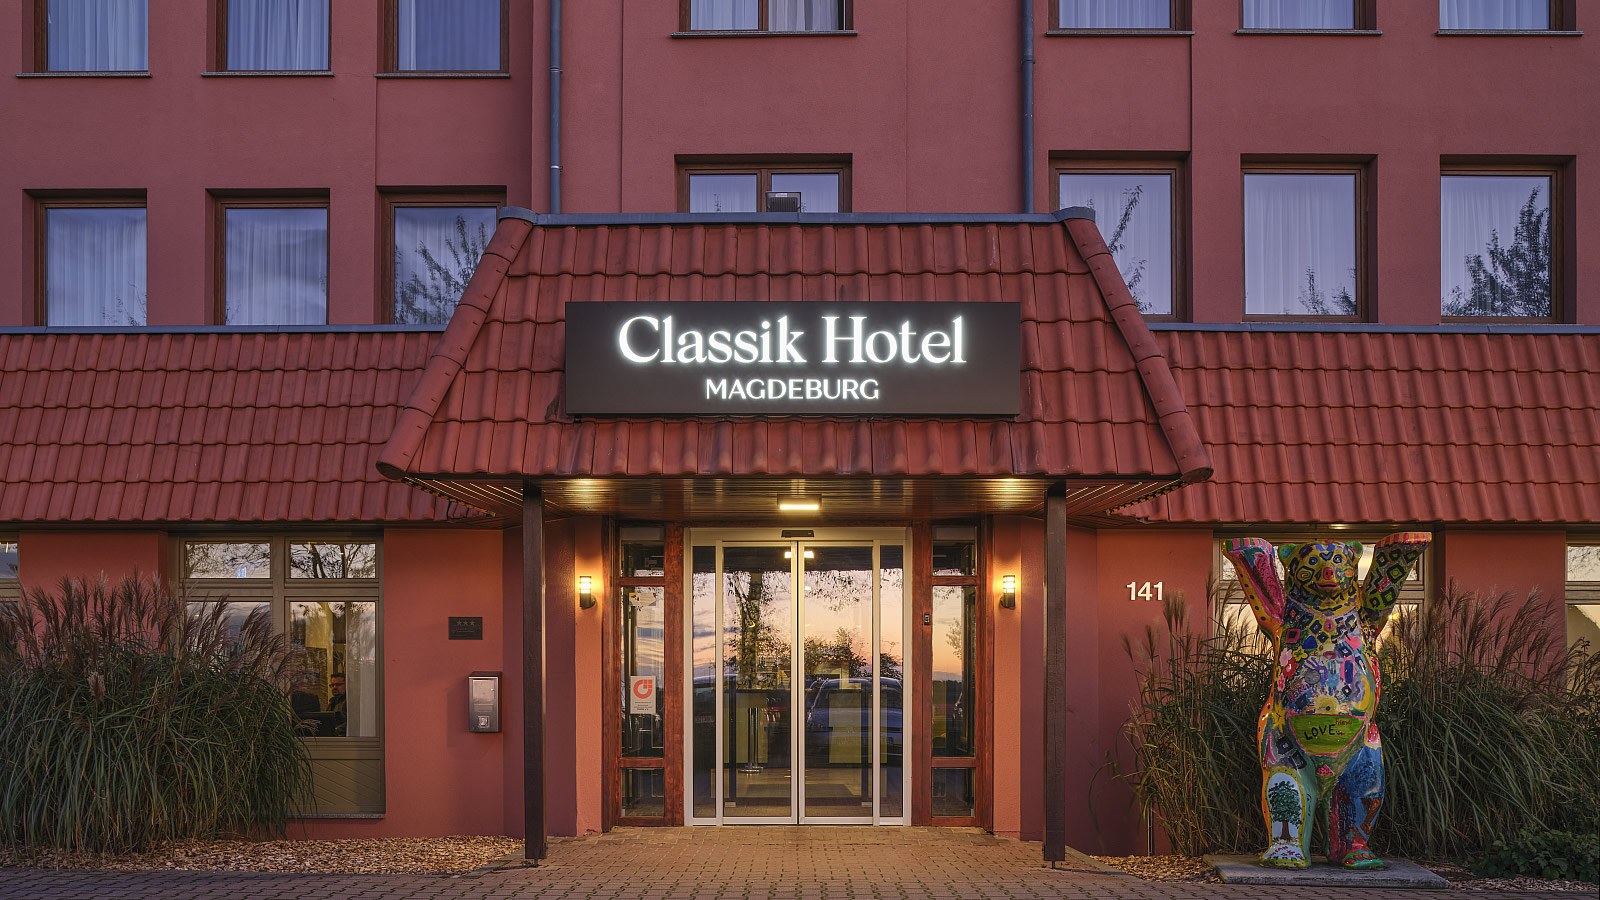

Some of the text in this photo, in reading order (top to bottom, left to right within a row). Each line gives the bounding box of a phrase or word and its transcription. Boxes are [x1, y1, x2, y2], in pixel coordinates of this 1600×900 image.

[618, 314, 967, 365] Classik Hotel
[705, 378, 880, 401] MAGDEBURG
[1126, 581, 1163, 601] 141
[1304, 724, 1336, 740] LOVE
